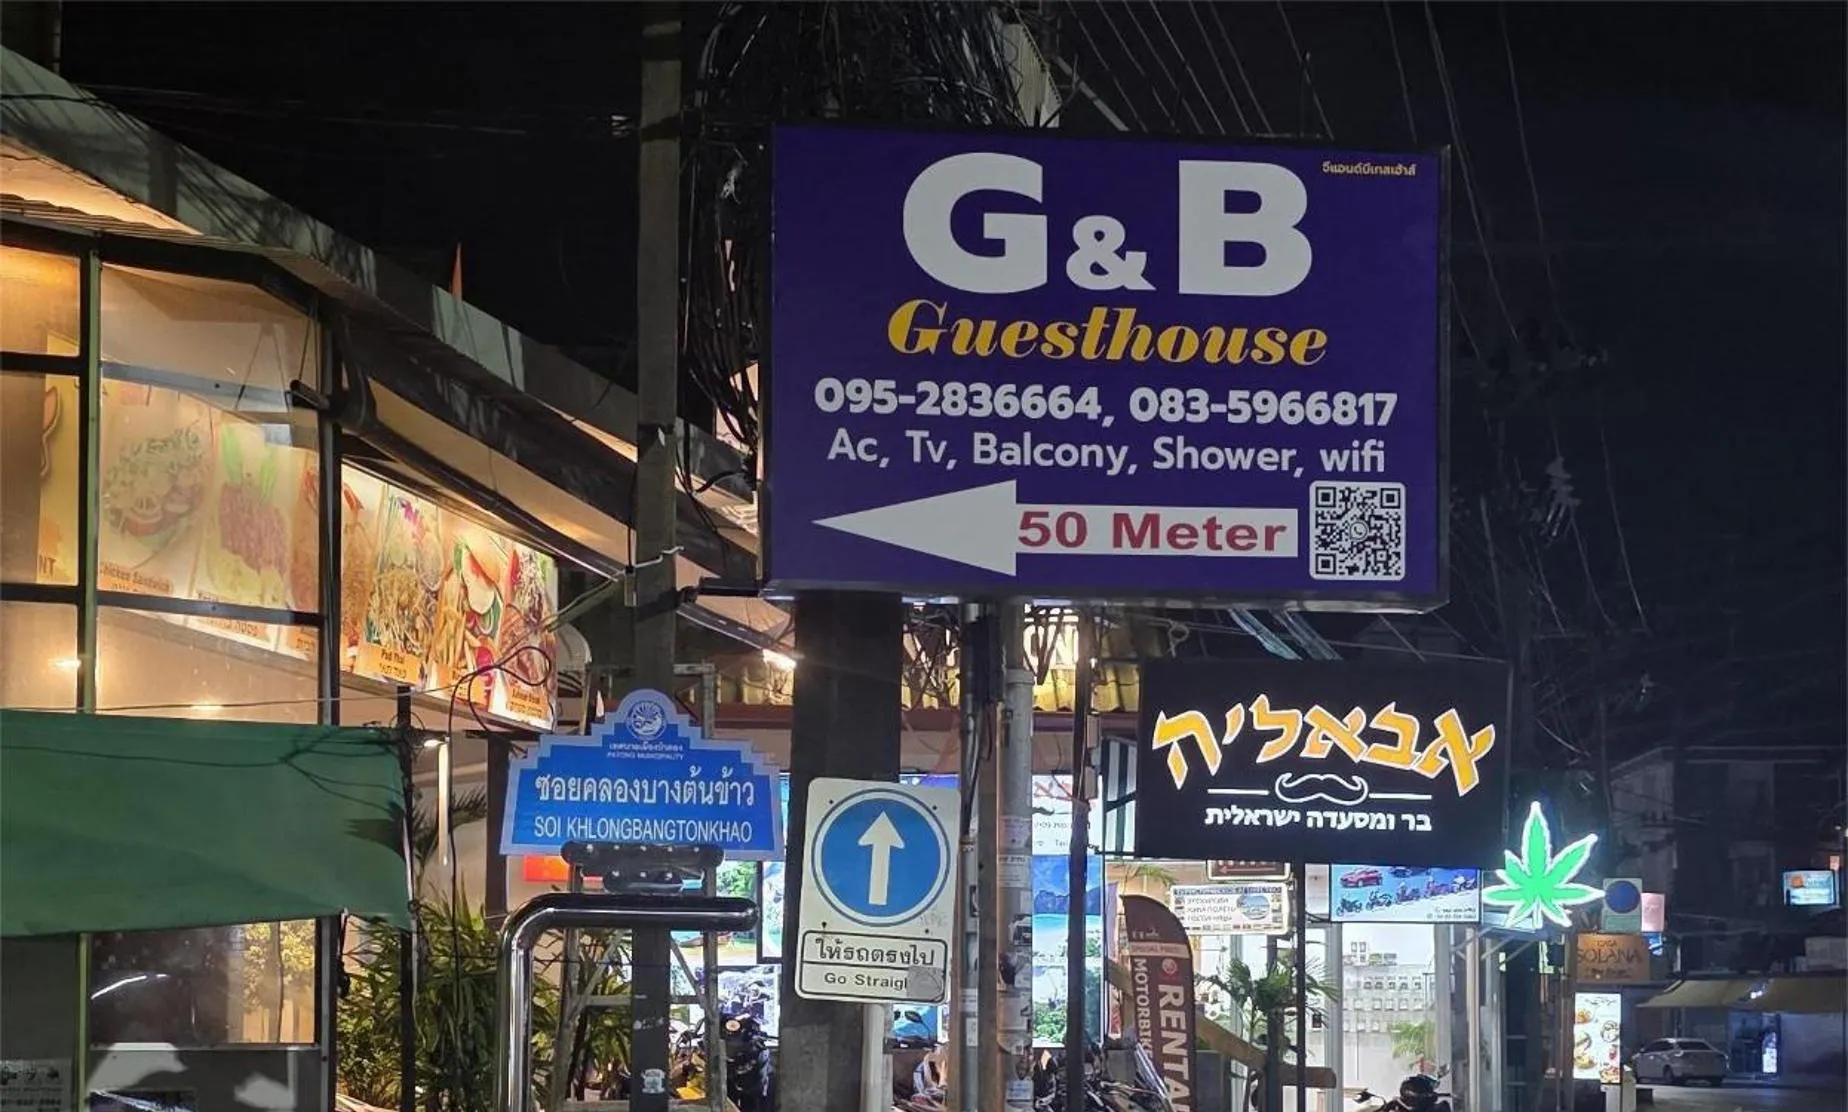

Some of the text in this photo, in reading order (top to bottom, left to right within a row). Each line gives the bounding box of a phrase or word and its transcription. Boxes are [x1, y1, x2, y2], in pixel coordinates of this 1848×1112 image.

[887, 298, 1329, 366] Guesthouse
[813, 377, 1398, 428] 095-2836664, 083-5966817
[828, 426, 1386, 477] Ac, Tv, Balcony, Shower, wifi
[1018, 511, 1288, 552] 50 Meter
[534, 764, 755, 806] ซอยคลองบางต้นข้าว
[534, 815, 753, 843] SOI KHLONGBANGTONKHAO
[1203, 804, 1433, 832] בר ומסעדה ישראלית
[815, 936, 935, 966] ให้รถตรงไป
[824, 972, 847, 985] Go
